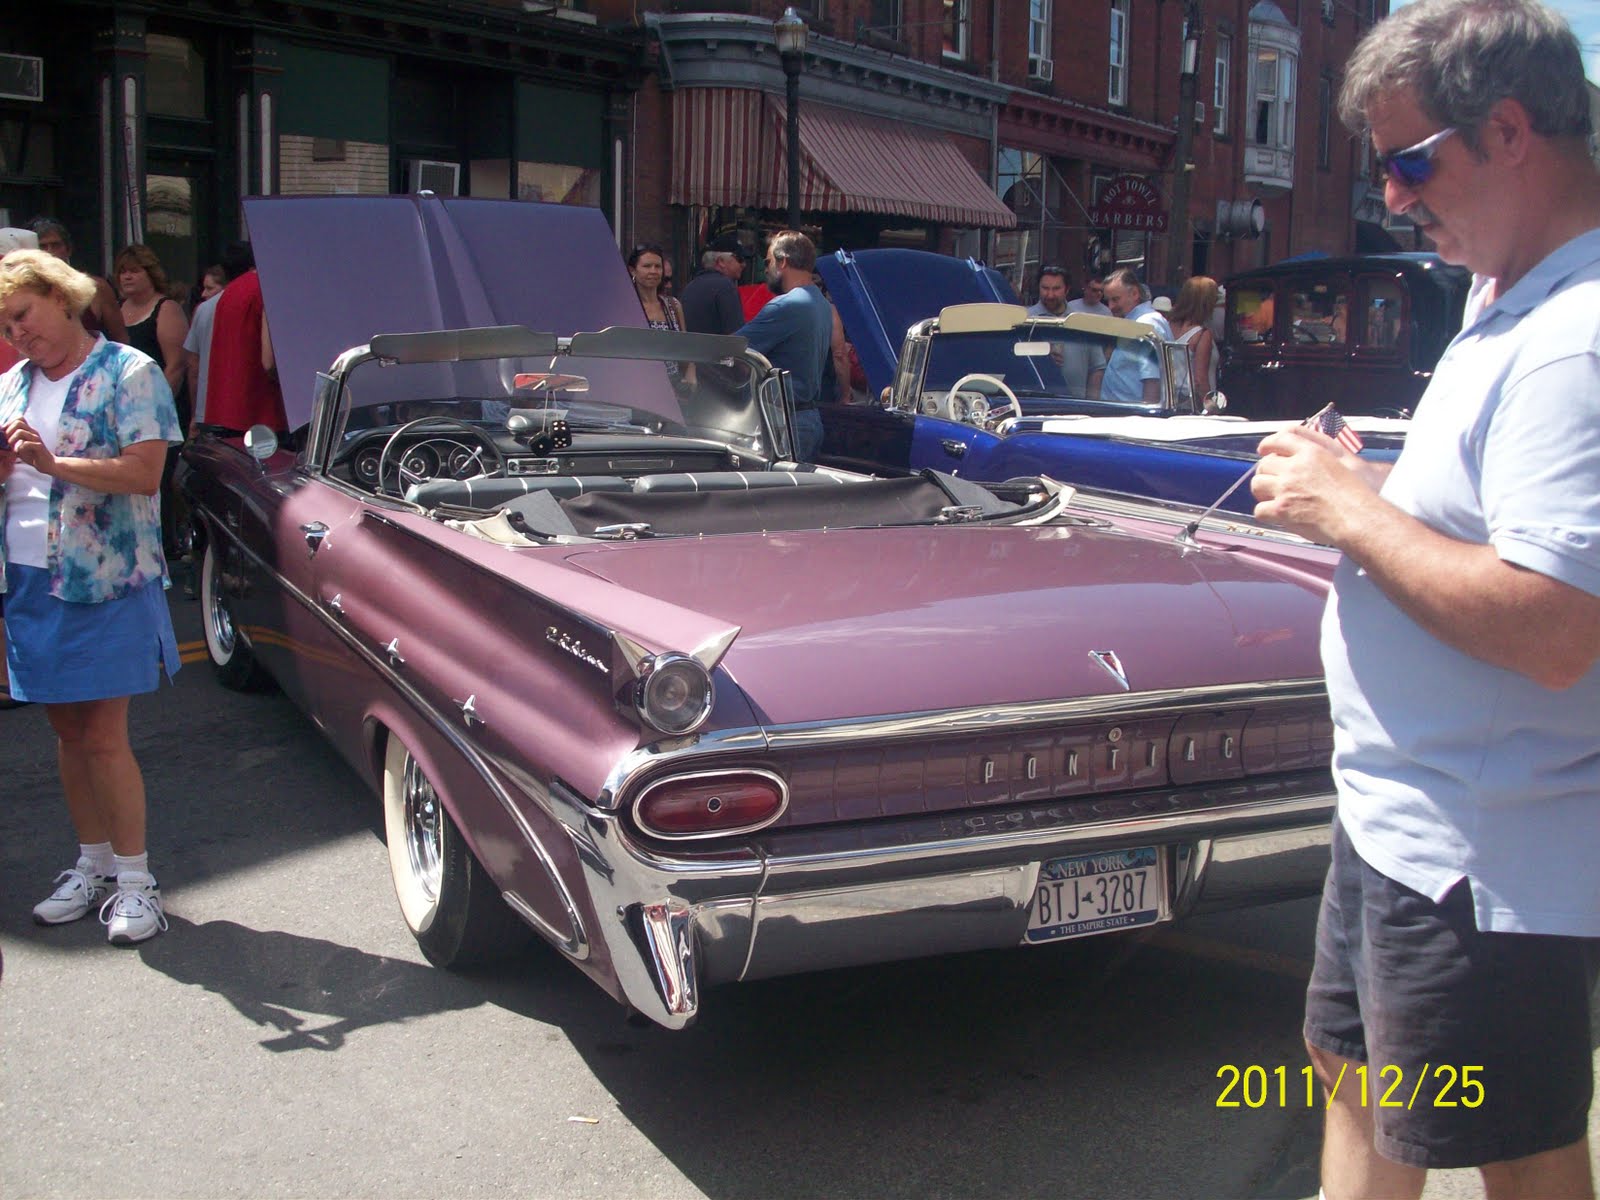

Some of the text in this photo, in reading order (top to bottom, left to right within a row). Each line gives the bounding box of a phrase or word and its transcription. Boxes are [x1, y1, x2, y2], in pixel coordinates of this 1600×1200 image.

[1104, 180, 1156, 207] HOT TOWEL
[1092, 211, 1165, 228] BARBERS
[984, 737, 1234, 784] PONTIAC
[1057, 854, 1127, 879] NEW YORK
[1038, 870, 1148, 925] BTJ 3287
[1060, 916, 1129, 935] THE EMPIRE STATE
